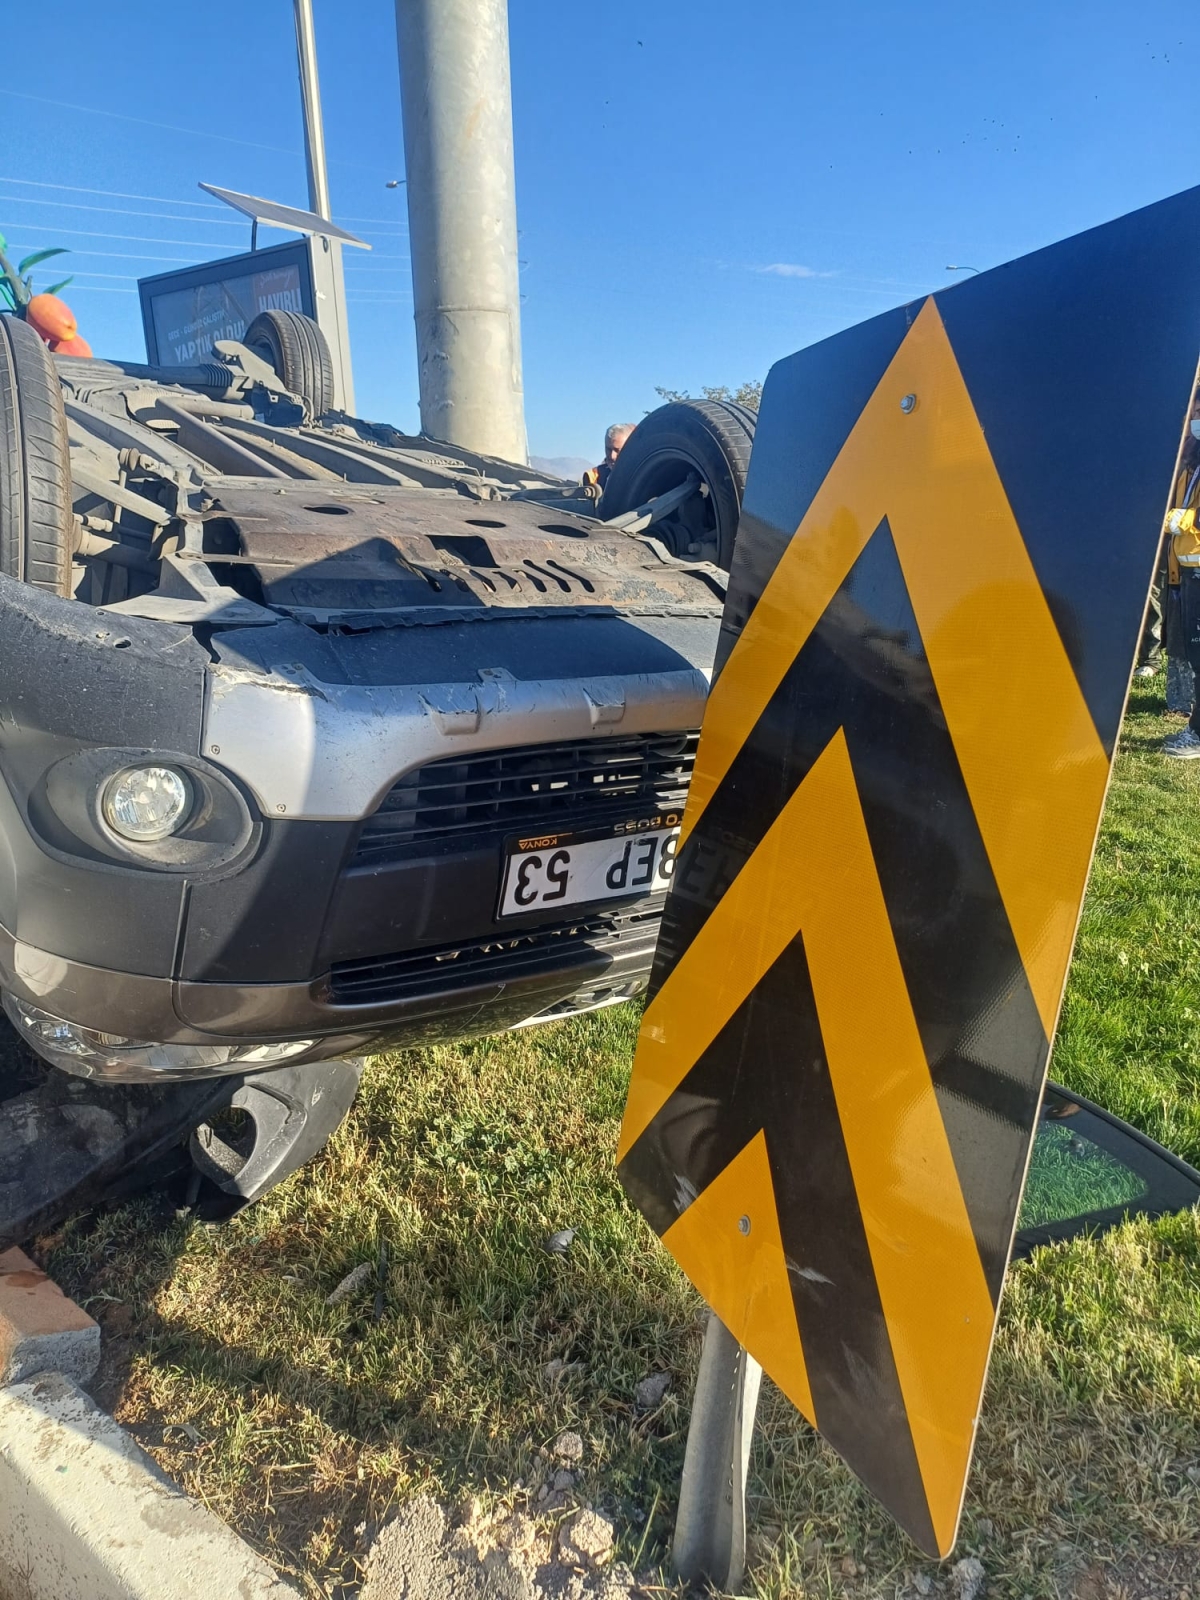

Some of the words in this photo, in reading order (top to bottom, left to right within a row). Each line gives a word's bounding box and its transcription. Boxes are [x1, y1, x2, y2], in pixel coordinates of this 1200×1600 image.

[174, 333, 212, 363] YAPTIK
[518, 836, 558, 850] KONYA
[514, 850, 571, 906] 53
